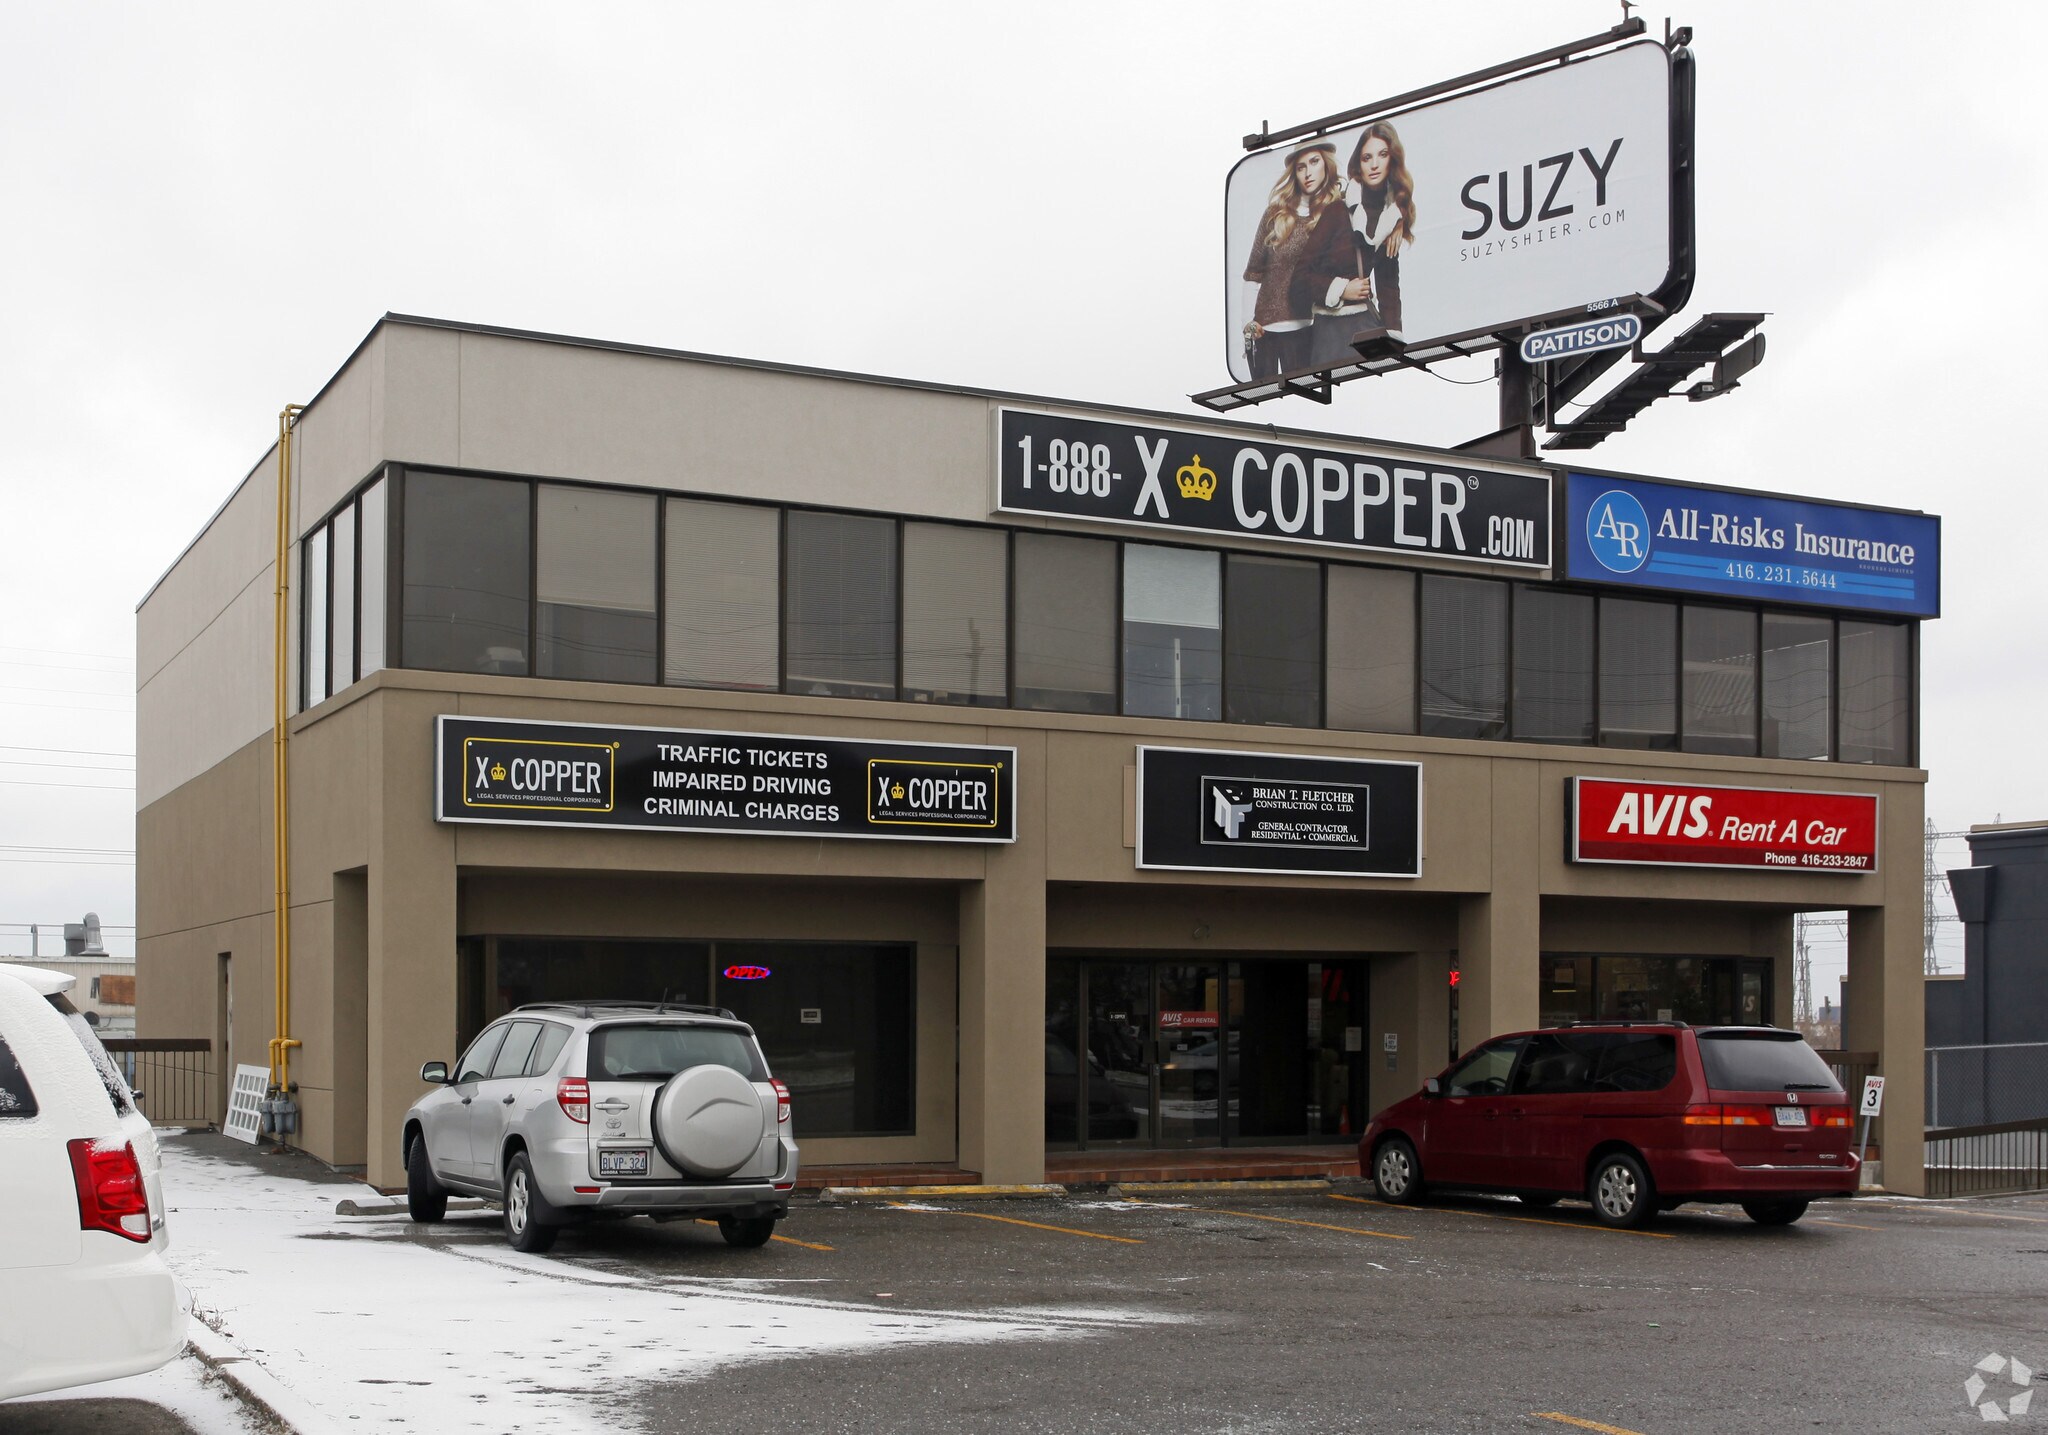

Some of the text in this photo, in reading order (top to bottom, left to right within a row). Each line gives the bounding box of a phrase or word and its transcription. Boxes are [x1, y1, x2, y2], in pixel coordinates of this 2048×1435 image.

[1460, 138, 1624, 240] SUZY
[1460, 209, 1626, 262] SUZYSHIER.COM
[1587, 298, 1619, 313] 5566 A
[1531, 321, 1631, 356] PATTISON
[1018, 434, 1122, 498] 1-888-
[1133, 435, 1170, 519] X
[1232, 448, 1467, 551] COPPER
[1481, 514, 1535, 559] .COM
[1656, 508, 1915, 566] All-Risks Insurance
[657, 744, 828, 769] TRAFFIC TICKETS
[475, 756, 601, 794] X COPPER
[652, 771, 832, 795] IMPAIRED DRIVING
[563, 796, 601, 804] CORPORATION
[878, 776, 987, 811] X COPPER
[1252, 787, 1355, 804] BRIAN T. FLETCHER
[643, 798, 840, 822] CRIMINAL CHARGES
[1255, 800, 1354, 813] CONSTRUCTION CO. LTD.
[1258, 821, 1349, 833] GENERAL CONTRACTOR
[1606, 791, 1847, 846] AVIS Rent A Car
[1251, 830, 1359, 843] RESIDENTIAL COMMERCIAL
[1765, 852, 1868, 868] Phone 416-233-2847
[726, 965, 768, 978] OPEN
[1161, 1013, 1182, 1022] AVIS
[1866, 1080, 1883, 1089] AVIS
[1867, 1089, 1878, 1107] 3
[602, 1157, 645, 1169] BLVP 324
